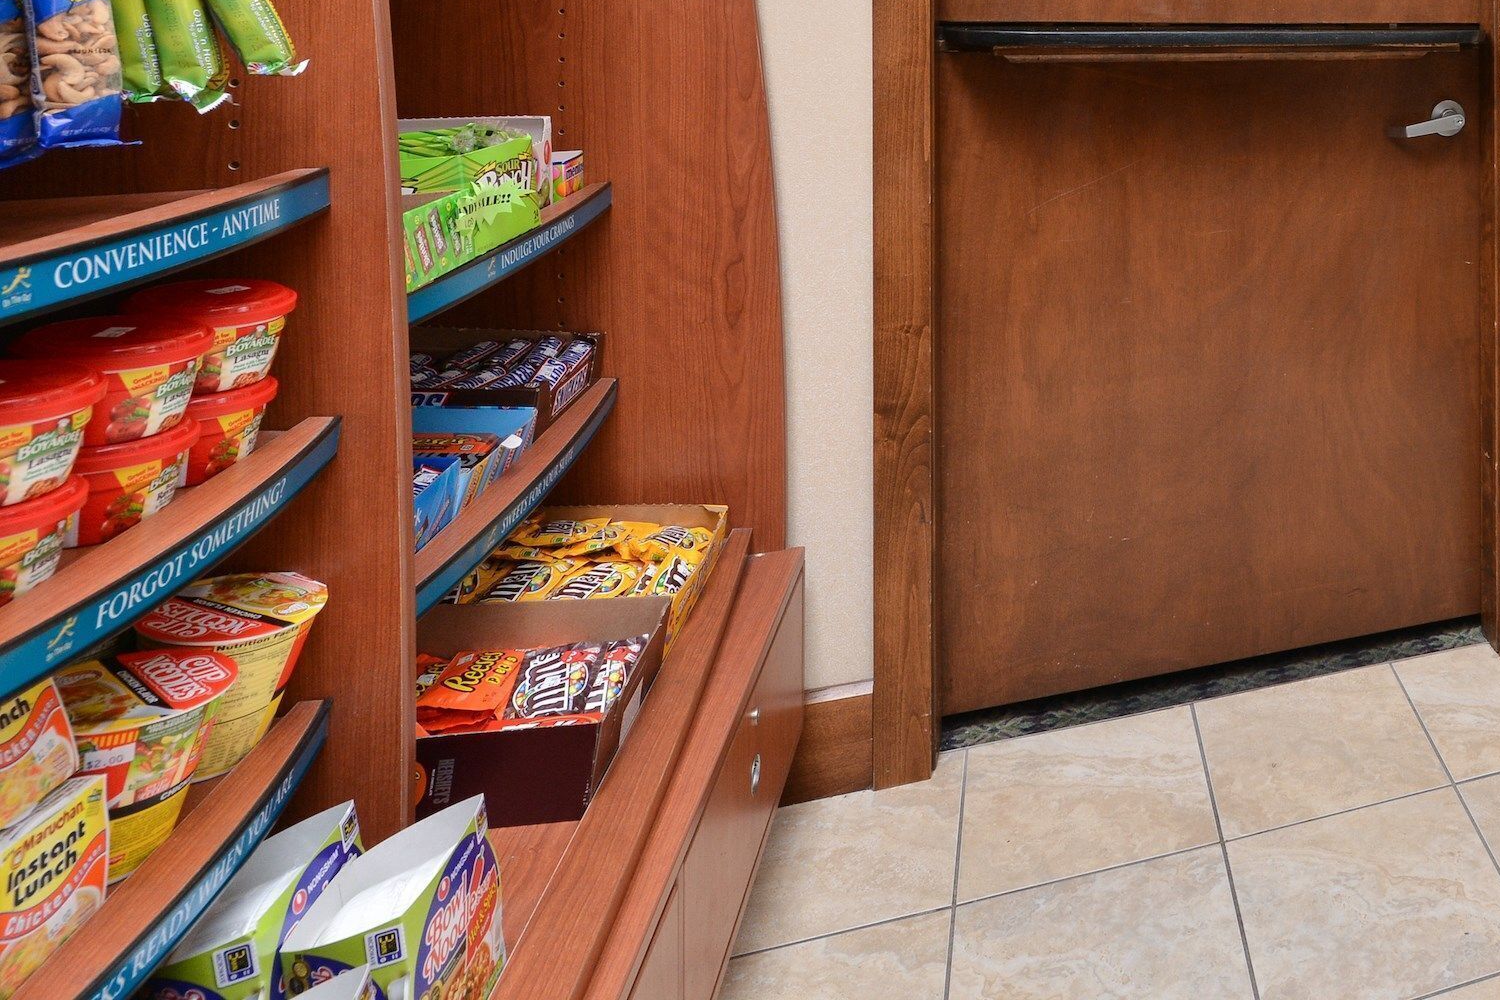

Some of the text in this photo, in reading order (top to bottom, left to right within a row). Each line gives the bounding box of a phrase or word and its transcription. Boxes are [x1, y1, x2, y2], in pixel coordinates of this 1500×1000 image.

[494, 159, 521, 174] SOUR
[53, 221, 209, 289] CONVENIENCE
[221, 198, 281, 240] ANYTIME
[501, 214, 575, 269] INDULGE YOUR CRAVINGS
[27, 448, 73, 471] Lasagna
[501, 505, 529, 534] SWEETS
[528, 489, 542, 508] FOR
[95, 476, 288, 630] FORGOT SOMETHING?
[216, 624, 300, 653] Nutrition Facts
[134, 653, 208, 701] NOODLES
[179, 655, 231, 683] CUP
[87, 753, 124, 770] $2.00
[22, 800, 85, 855] Maruchan
[7, 819, 86, 894] Instant
[12, 846, 78, 909] Lunch
[131, 767, 297, 974] READY WHEN YOU ARE
[306, 844, 341, 896] NONGSHIM
[425, 868, 468, 947] Bowl
